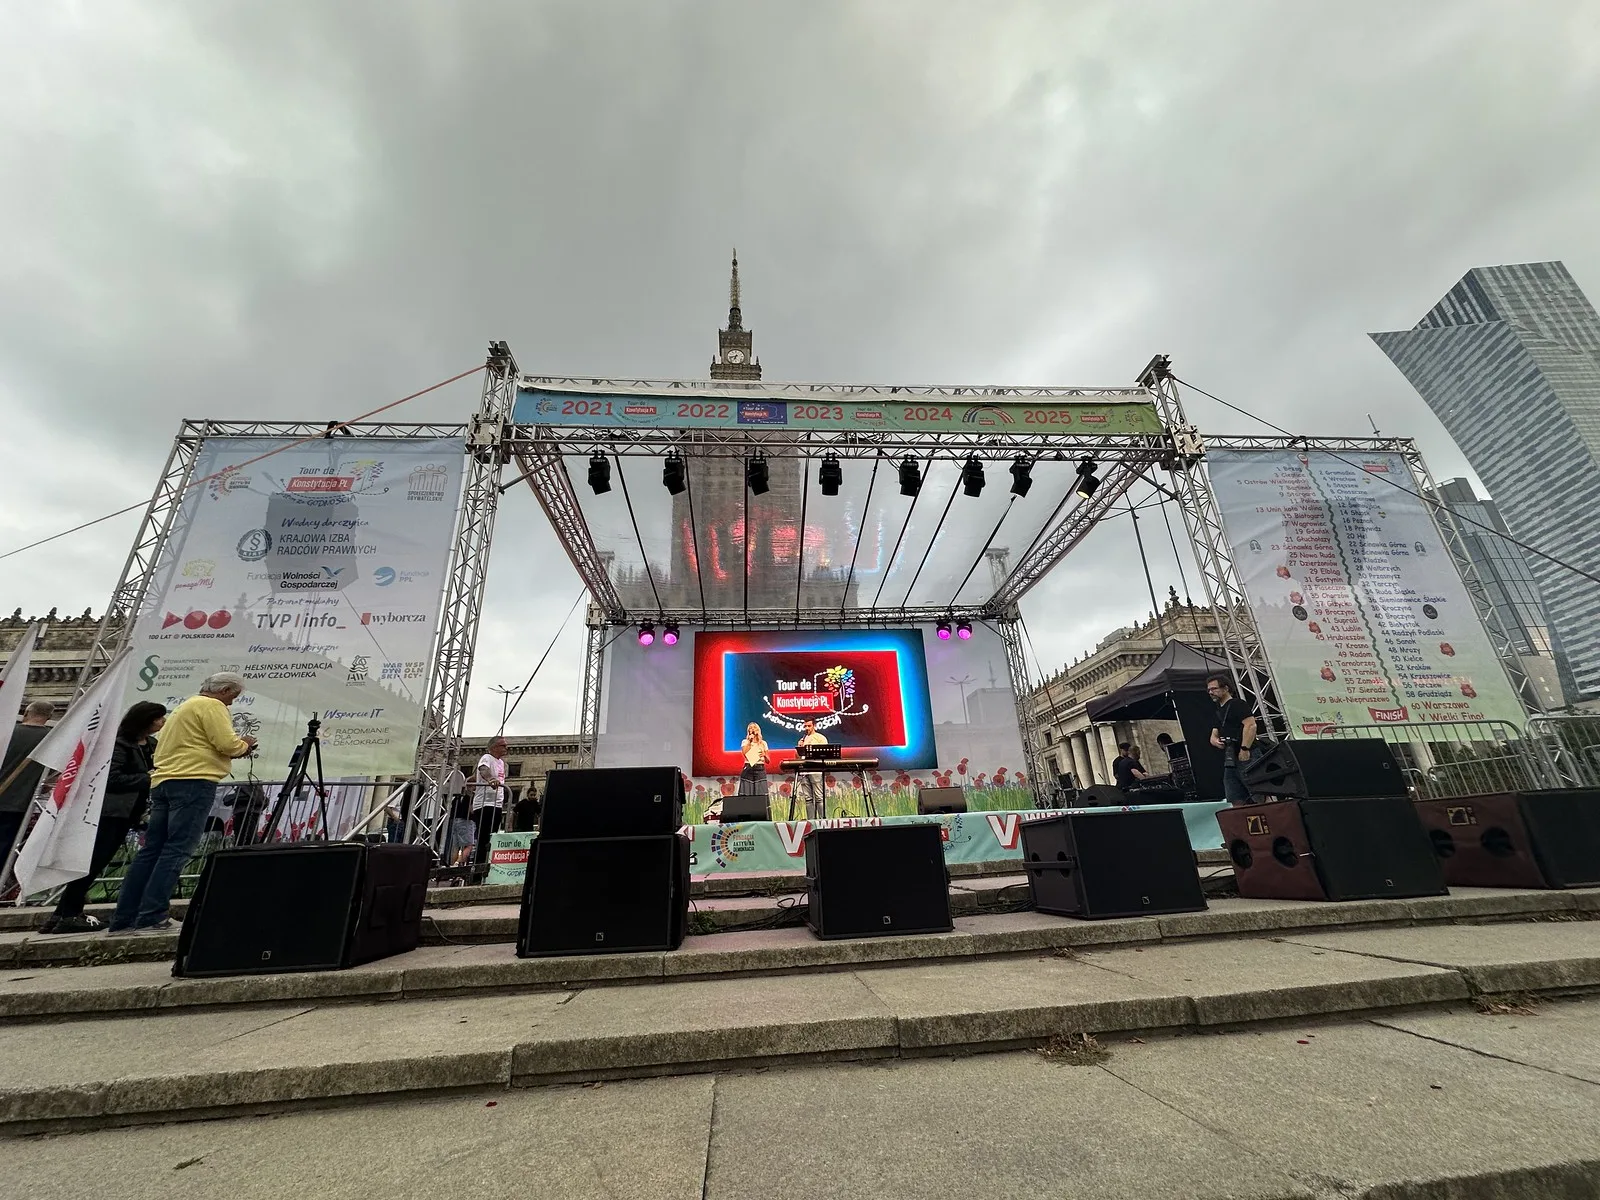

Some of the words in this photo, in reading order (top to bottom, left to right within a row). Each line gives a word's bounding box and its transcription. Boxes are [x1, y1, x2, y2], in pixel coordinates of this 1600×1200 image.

[562, 400, 613, 416] 2021
[678, 404, 729, 418] 2022
[794, 406, 844, 420] 2023
[904, 408, 953, 420] 2024
[1024, 411, 1072, 424] 2025
[300, 467, 320, 475] Tour
[322, 466, 334, 475] de
[291, 479, 338, 490] Konstytucja
[339, 478, 348, 488] PL
[280, 534, 326, 543] KRAJOWA
[330, 533, 350, 542] IZBA
[277, 545, 320, 555] RADCÓW
[322, 545, 376, 554] PRAWNYCH
[247, 572, 281, 580] Fundacja
[282, 572, 320, 580] Wolności
[280, 580, 338, 590] Gospodarczej
[257, 614, 291, 628] TVP
[372, 612, 426, 625] wyborcza
[248, 644, 286, 654] Wsparcie
[290, 662, 333, 670] FUNDACJA
[242, 672, 266, 680] PRAW
[268, 671, 317, 679] CZŁOWIEKA
[776, 680, 798, 690] Tour
[800, 678, 812, 690] de
[776, 696, 819, 710] Konstytucja
[820, 696, 828, 707] PL
[1421, 702, 1470, 710] Warszawa
[323, 710, 368, 720] Wsparcie
[370, 708, 384, 718] IT
[1375, 710, 1404, 720] FINISH
[1419, 714, 1425, 722] V
[1429, 712, 1458, 720] Wielki
[1461, 712, 1484, 720] Finał
[986, 814, 1023, 850] V
[775, 820, 812, 857] V
[494, 852, 526, 862] Konstytucja
